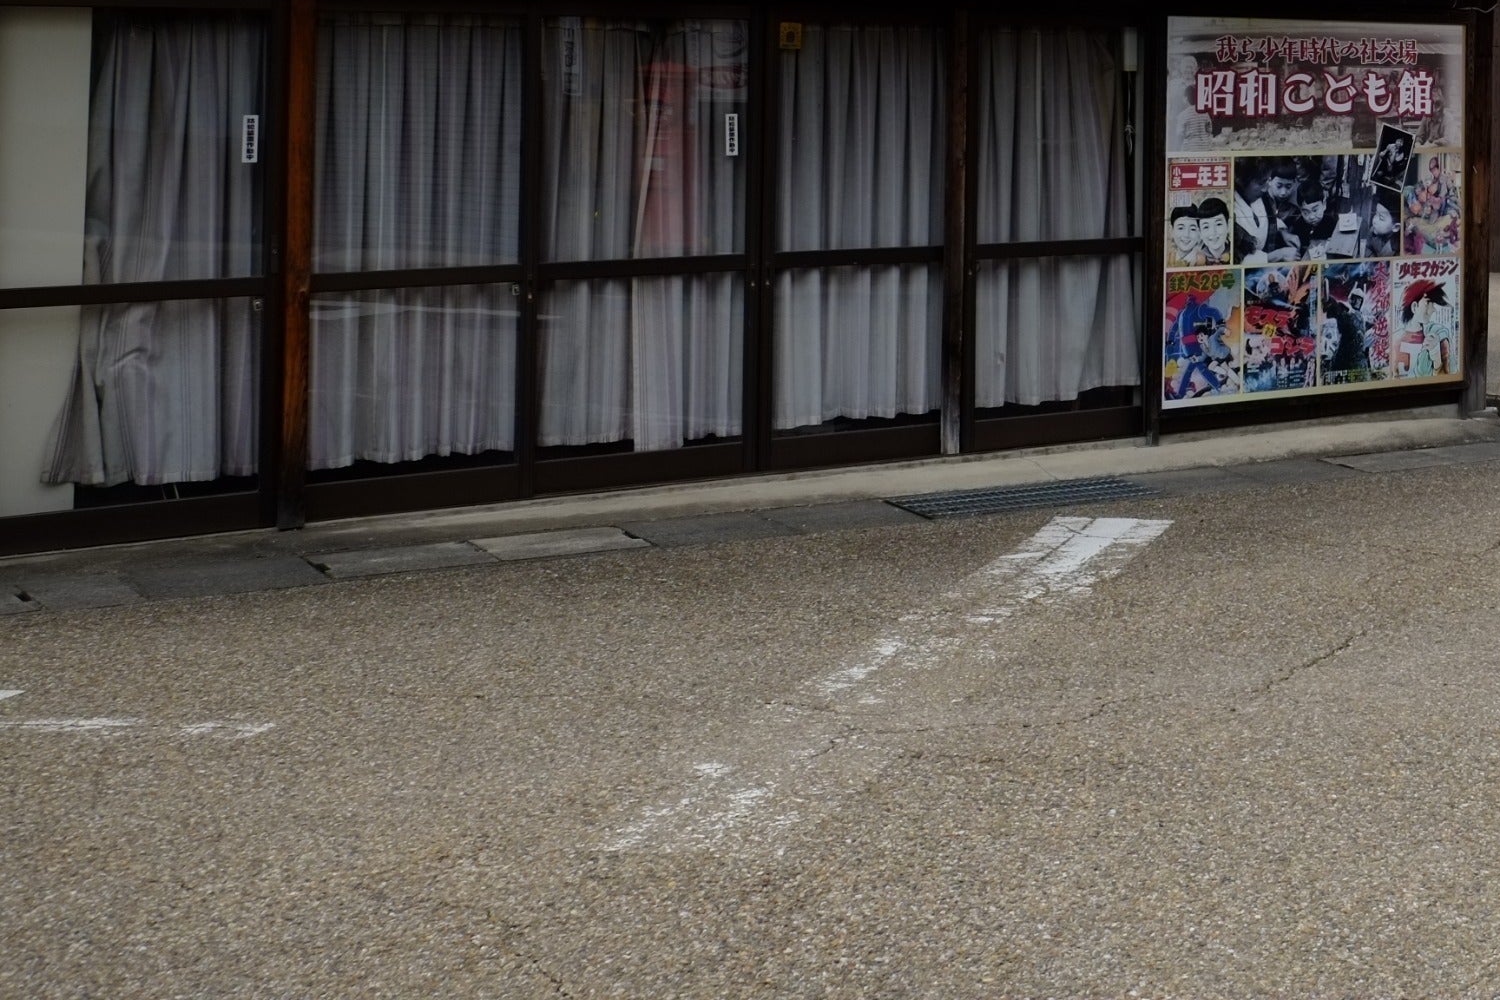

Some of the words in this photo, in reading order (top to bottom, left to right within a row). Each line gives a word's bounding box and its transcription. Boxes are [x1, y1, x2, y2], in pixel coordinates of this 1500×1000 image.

[1216, 36, 1418, 64] 我ら少年時代の社交場
[1196, 69, 1433, 117] 昭和こども館
[1399, 261, 1458, 279] 少年マガジン
